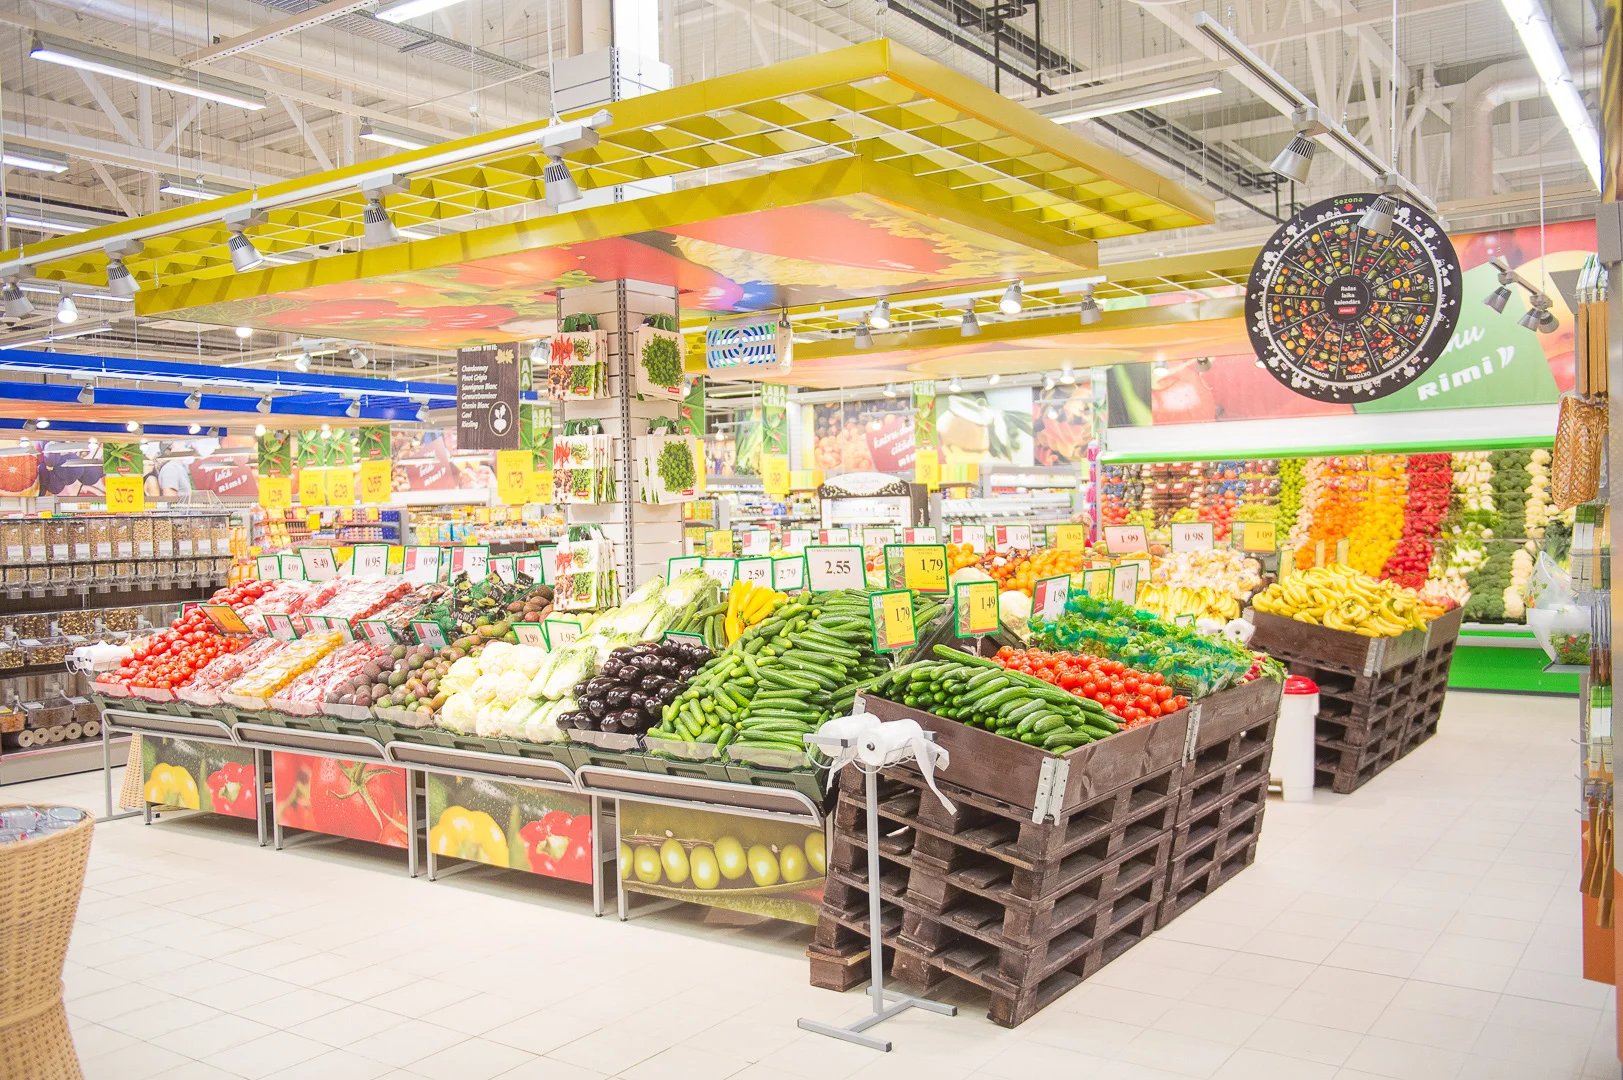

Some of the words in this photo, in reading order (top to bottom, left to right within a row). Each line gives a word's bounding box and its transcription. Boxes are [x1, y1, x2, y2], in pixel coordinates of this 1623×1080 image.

[1334, 197, 1363, 206] Sezona
[461, 365, 489, 373] Chardonnay
[474, 374, 488, 383] Grigio
[461, 384, 484, 392] Sauvignon
[461, 421, 479, 430] Riesling
